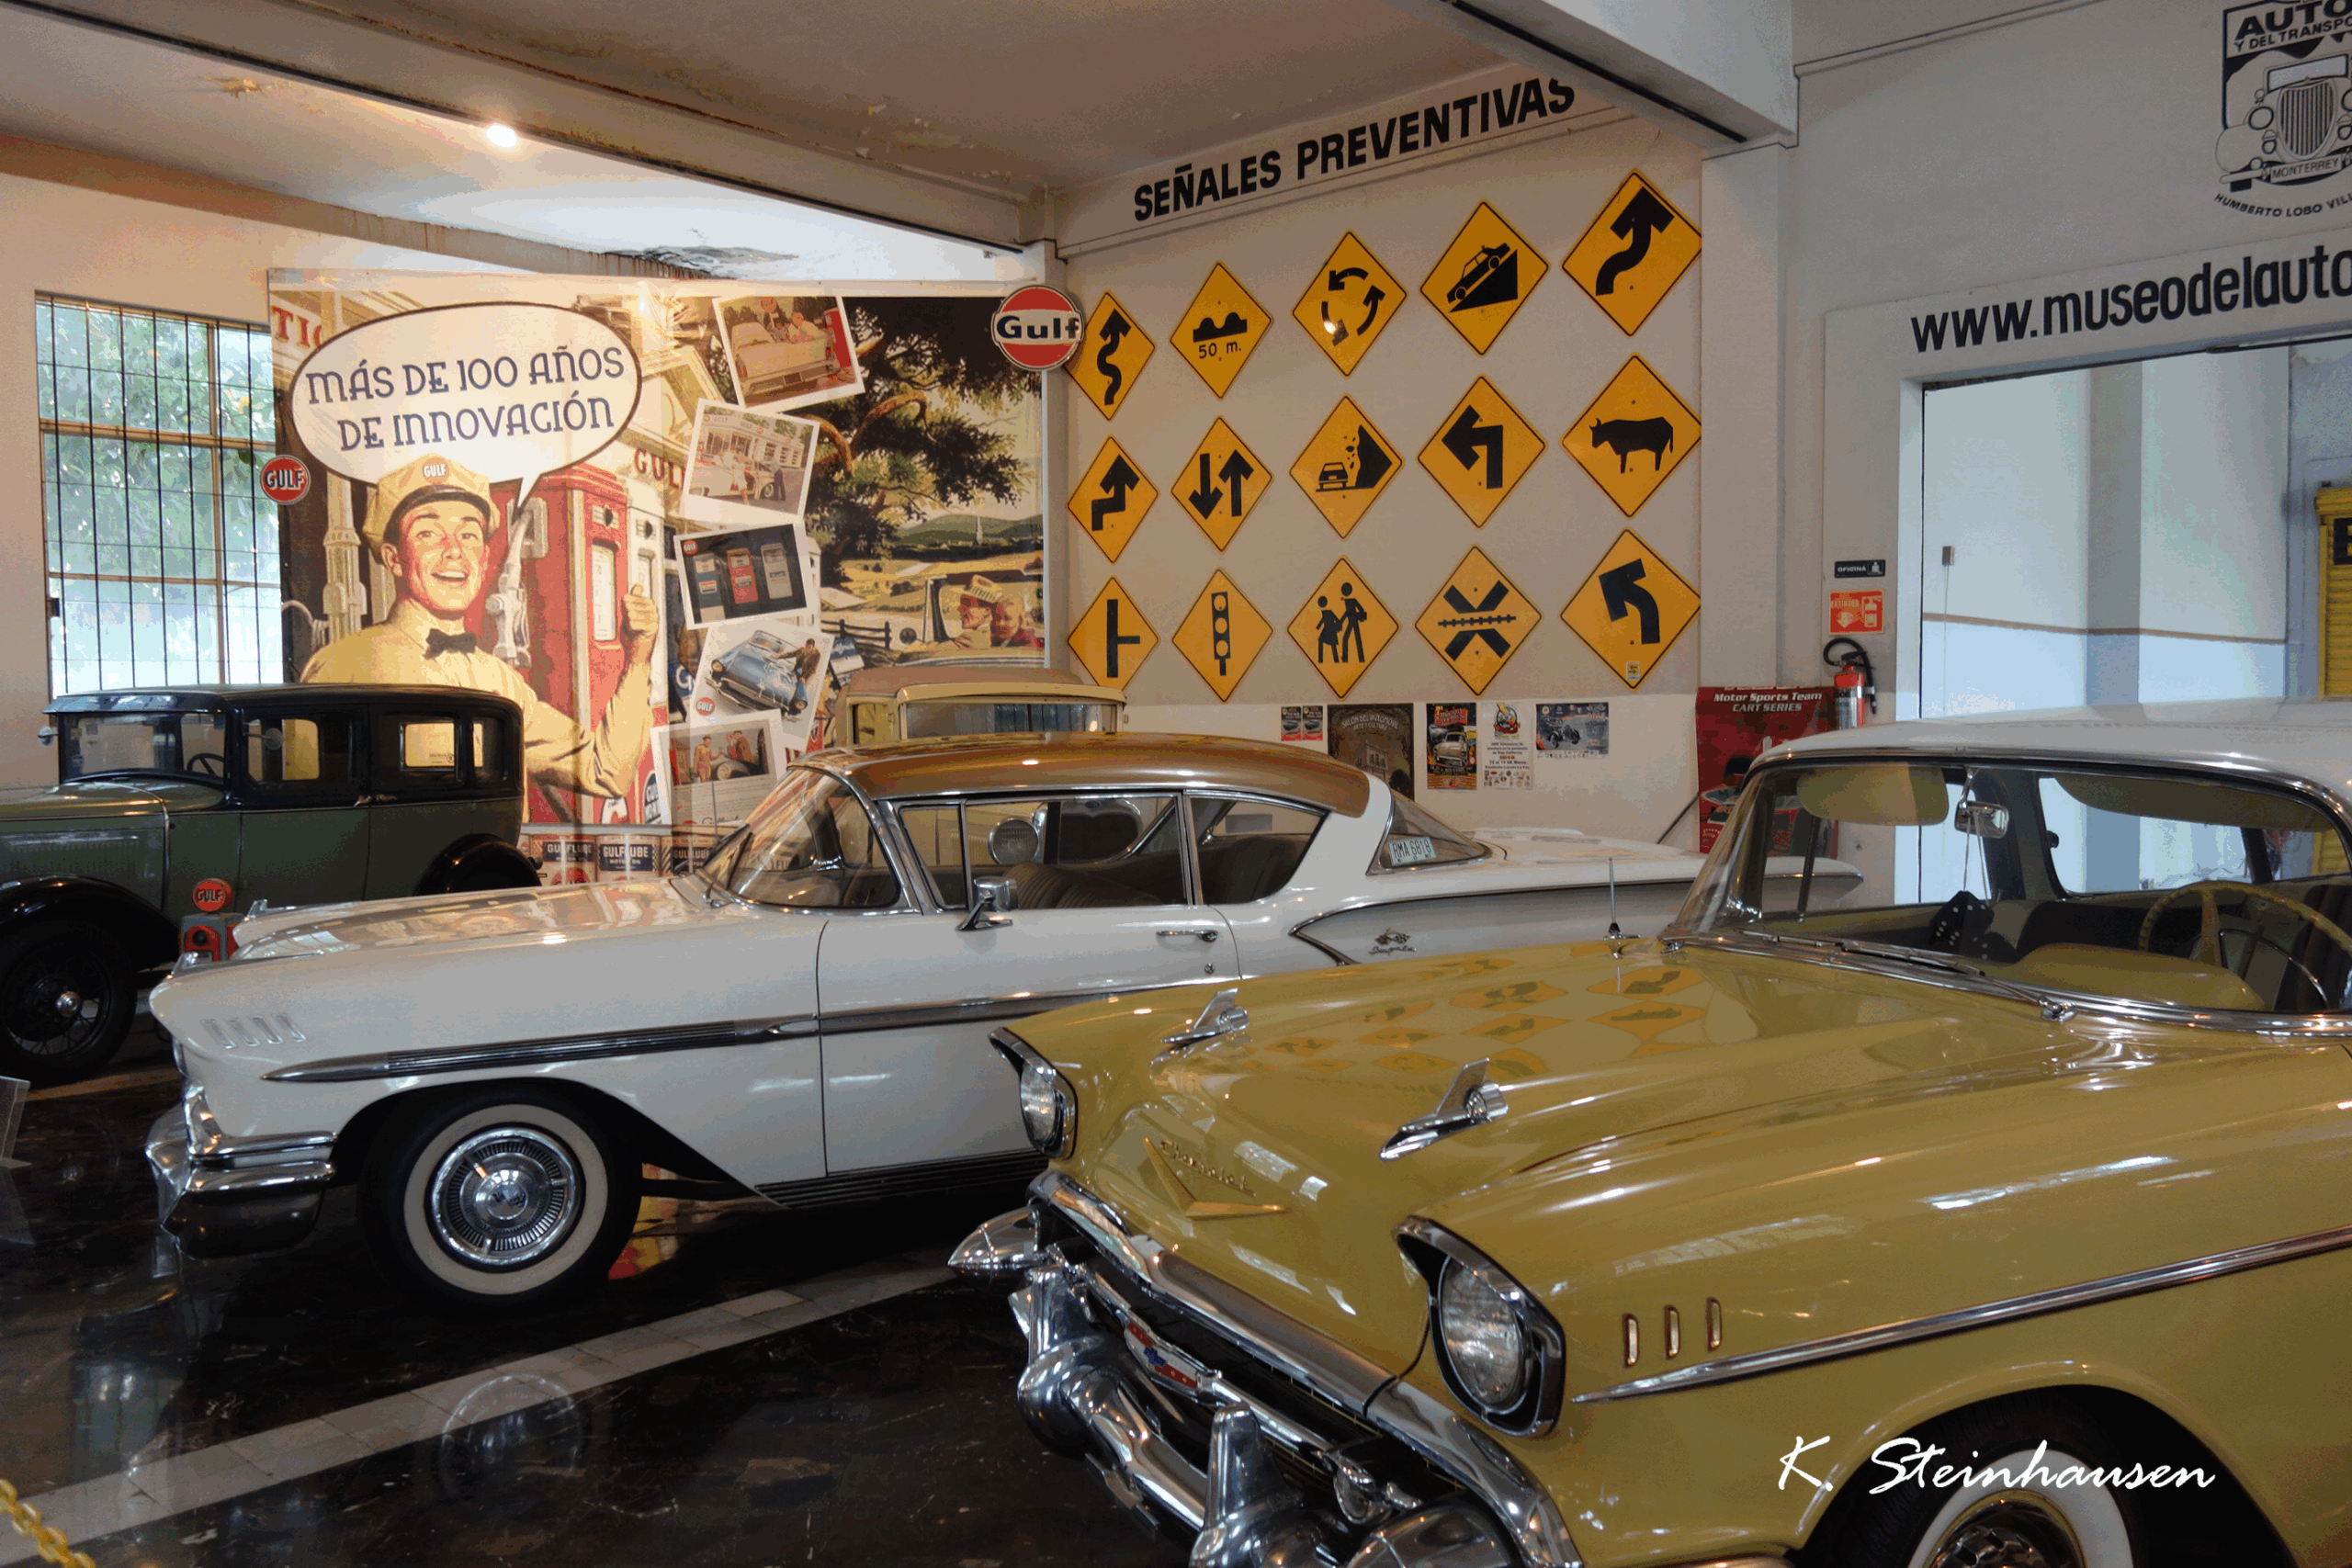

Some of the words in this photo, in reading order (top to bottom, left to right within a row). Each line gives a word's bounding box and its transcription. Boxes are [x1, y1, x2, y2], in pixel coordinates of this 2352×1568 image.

[2233, 40, 2245, 52] Y
[2249, 36, 2275, 50] DEL
[1134, 150, 1283, 221] SEÑALES
[1296, 77, 1576, 181] PREVENTIVAS
[2271, 157, 2339, 179] MONTERREY
[2214, 193, 2282, 217] HUMBERTO
[2286, 204, 2323, 217] LOBO
[995, 314, 1082, 340] Gulf
[1198, 341, 1218, 360] 50
[1226, 340, 1242, 355] m.
[306, 359, 393, 405] MÁS
[402, 361, 448, 397] DE
[458, 355, 518, 391] 100
[528, 345, 625, 386] AÑOS
[337, 416, 386, 451] DE
[393, 390, 615, 446] INNOVACIÓN
[264, 468, 306, 490] GULF
[422, 462, 447, 479] GULF
[696, 702, 714, 712] GULF
[1713, 693, 1749, 703] Motor
[1750, 693, 1789, 704] Sports
[1791, 692, 1823, 701] Team
[1732, 704, 1761, 712] CART
[1763, 703, 1803, 712] SERIES
[603, 846, 649, 857] GULFUBE
[1392, 842, 1410, 858] RMA
[1409, 839, 1431, 855] 6818
[198, 889, 223, 903] GULF
